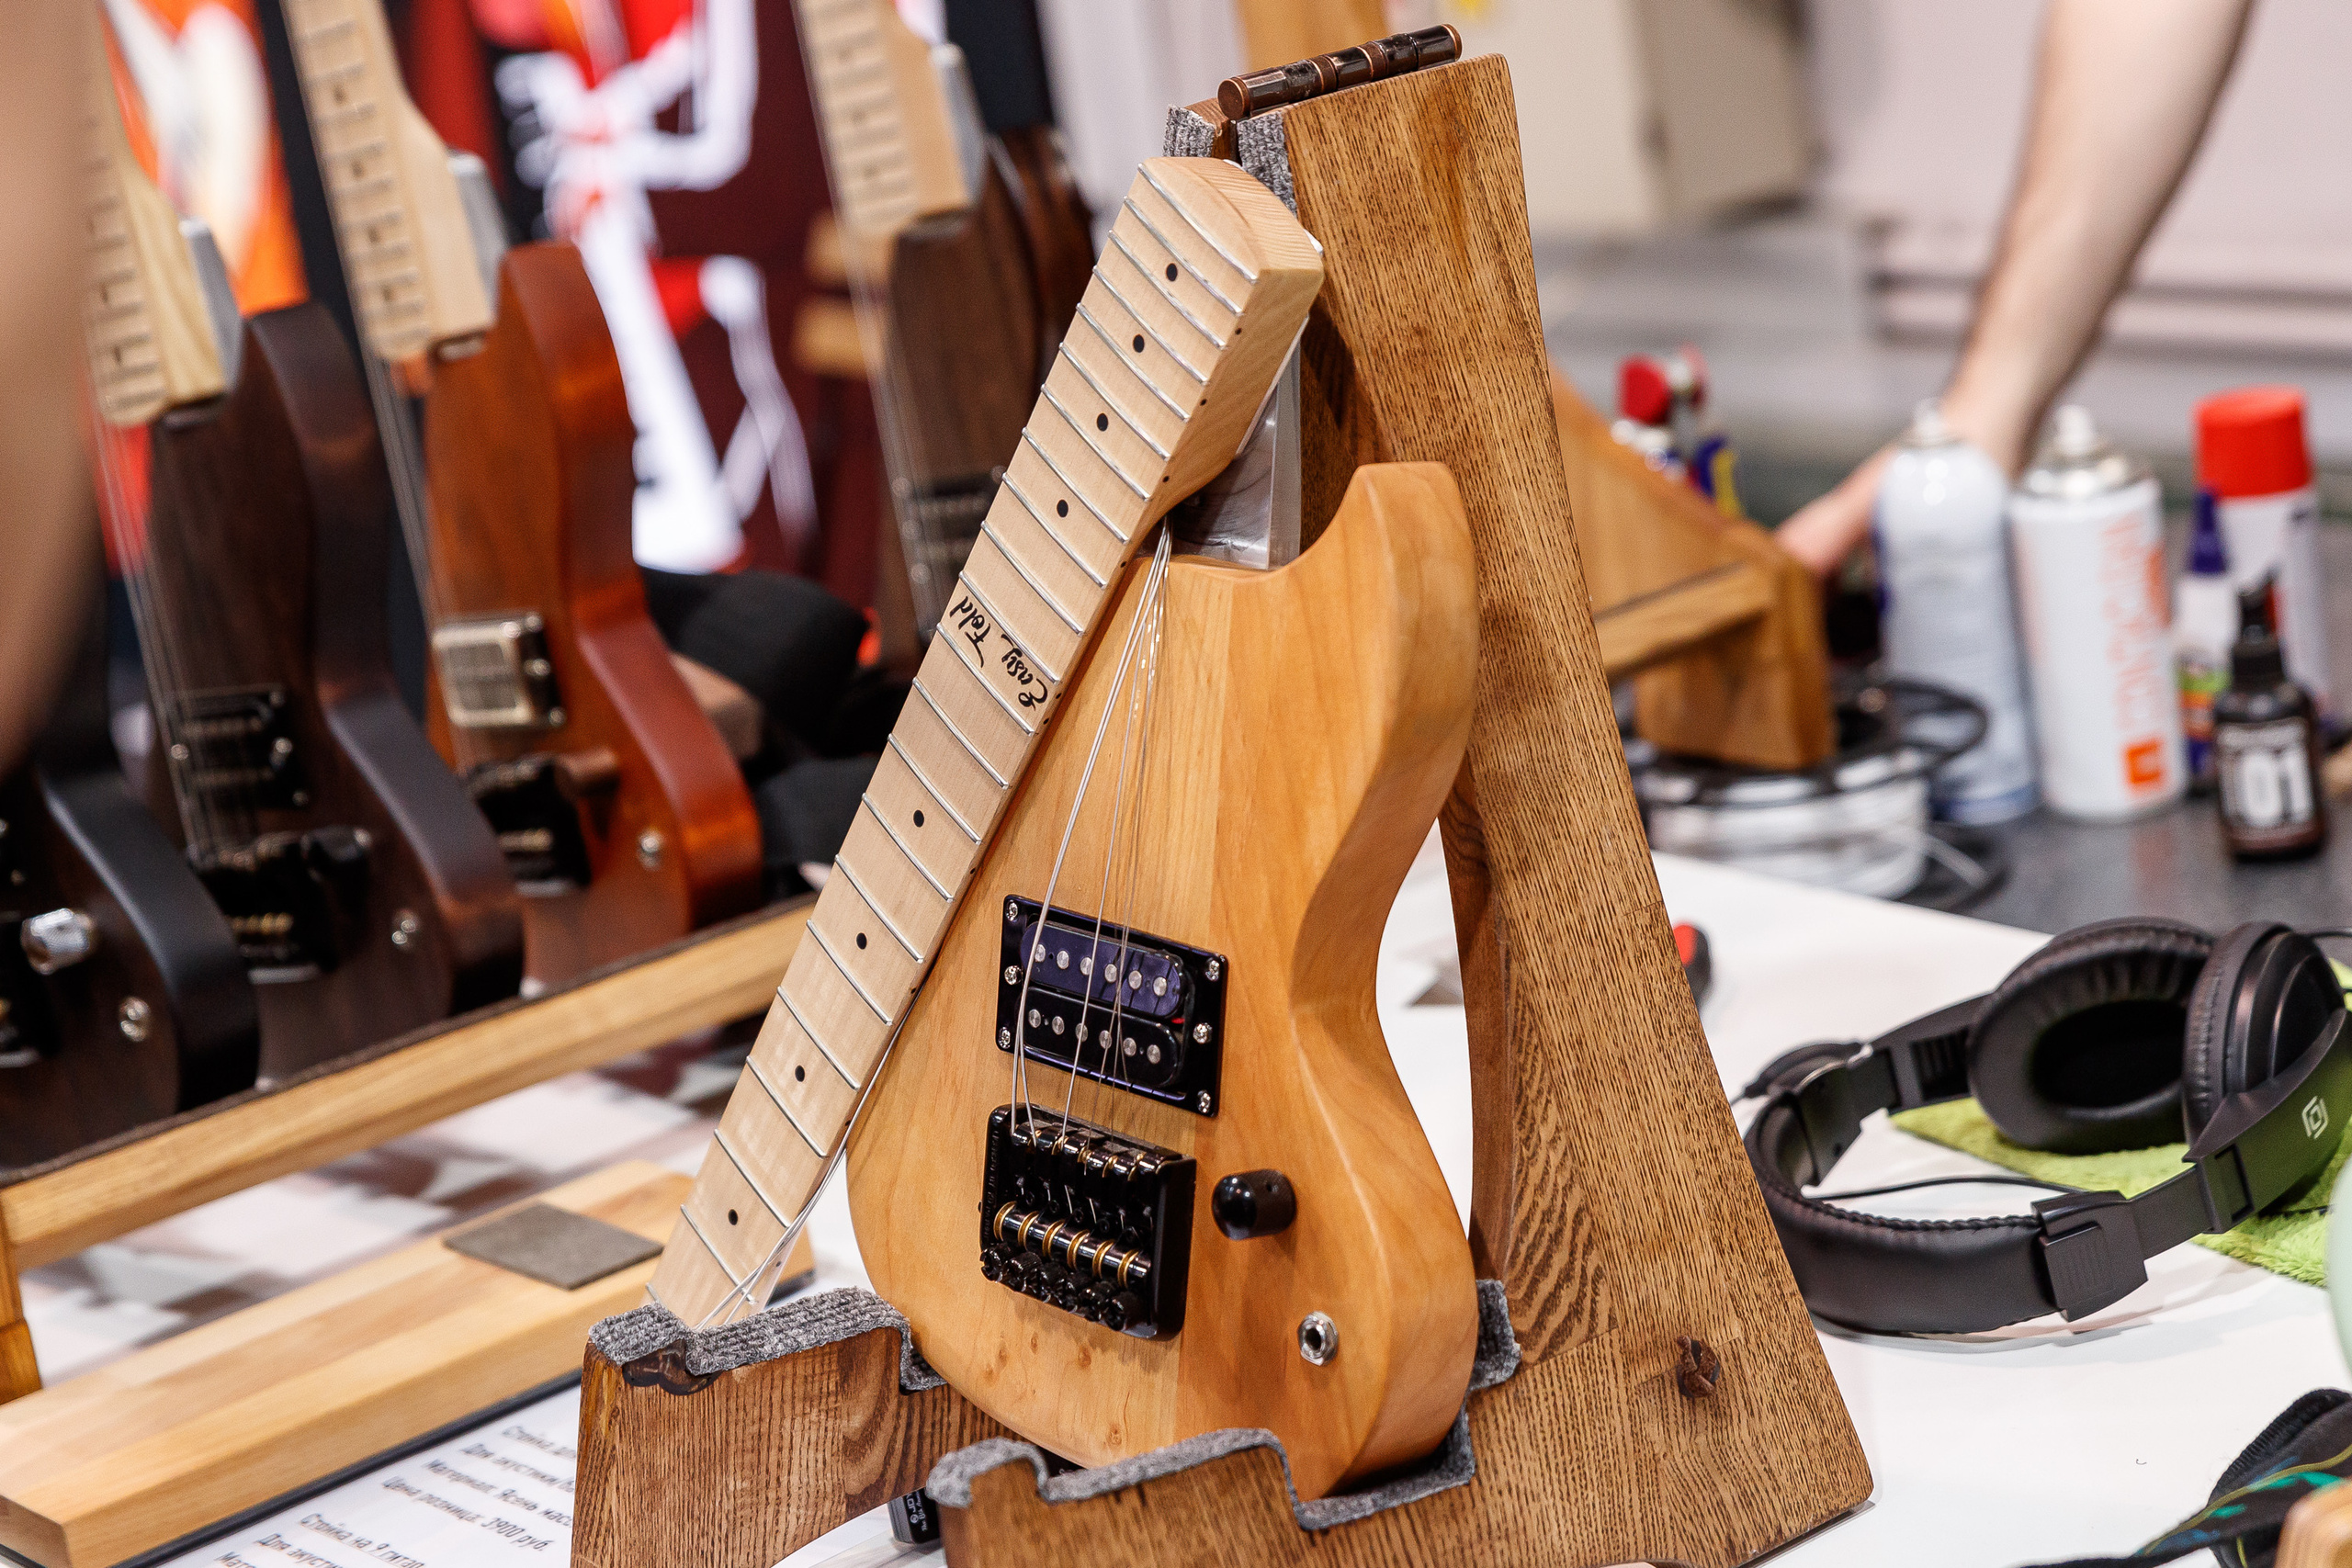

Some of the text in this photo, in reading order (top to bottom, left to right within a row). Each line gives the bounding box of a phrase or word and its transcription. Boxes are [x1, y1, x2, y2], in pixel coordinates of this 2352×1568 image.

[949, 595, 1048, 711] Easy Fold
[495, 1488, 538, 1511] Ясень
[538, 1507, 572, 1528] масс
[254, 1533, 291, 1551] Для
[299, 1513, 353, 1540] Стойка
[349, 1537, 373, 1550] на
[481, 1517, 526, 1538] 3900
[510, 1533, 554, 1551] руб.
